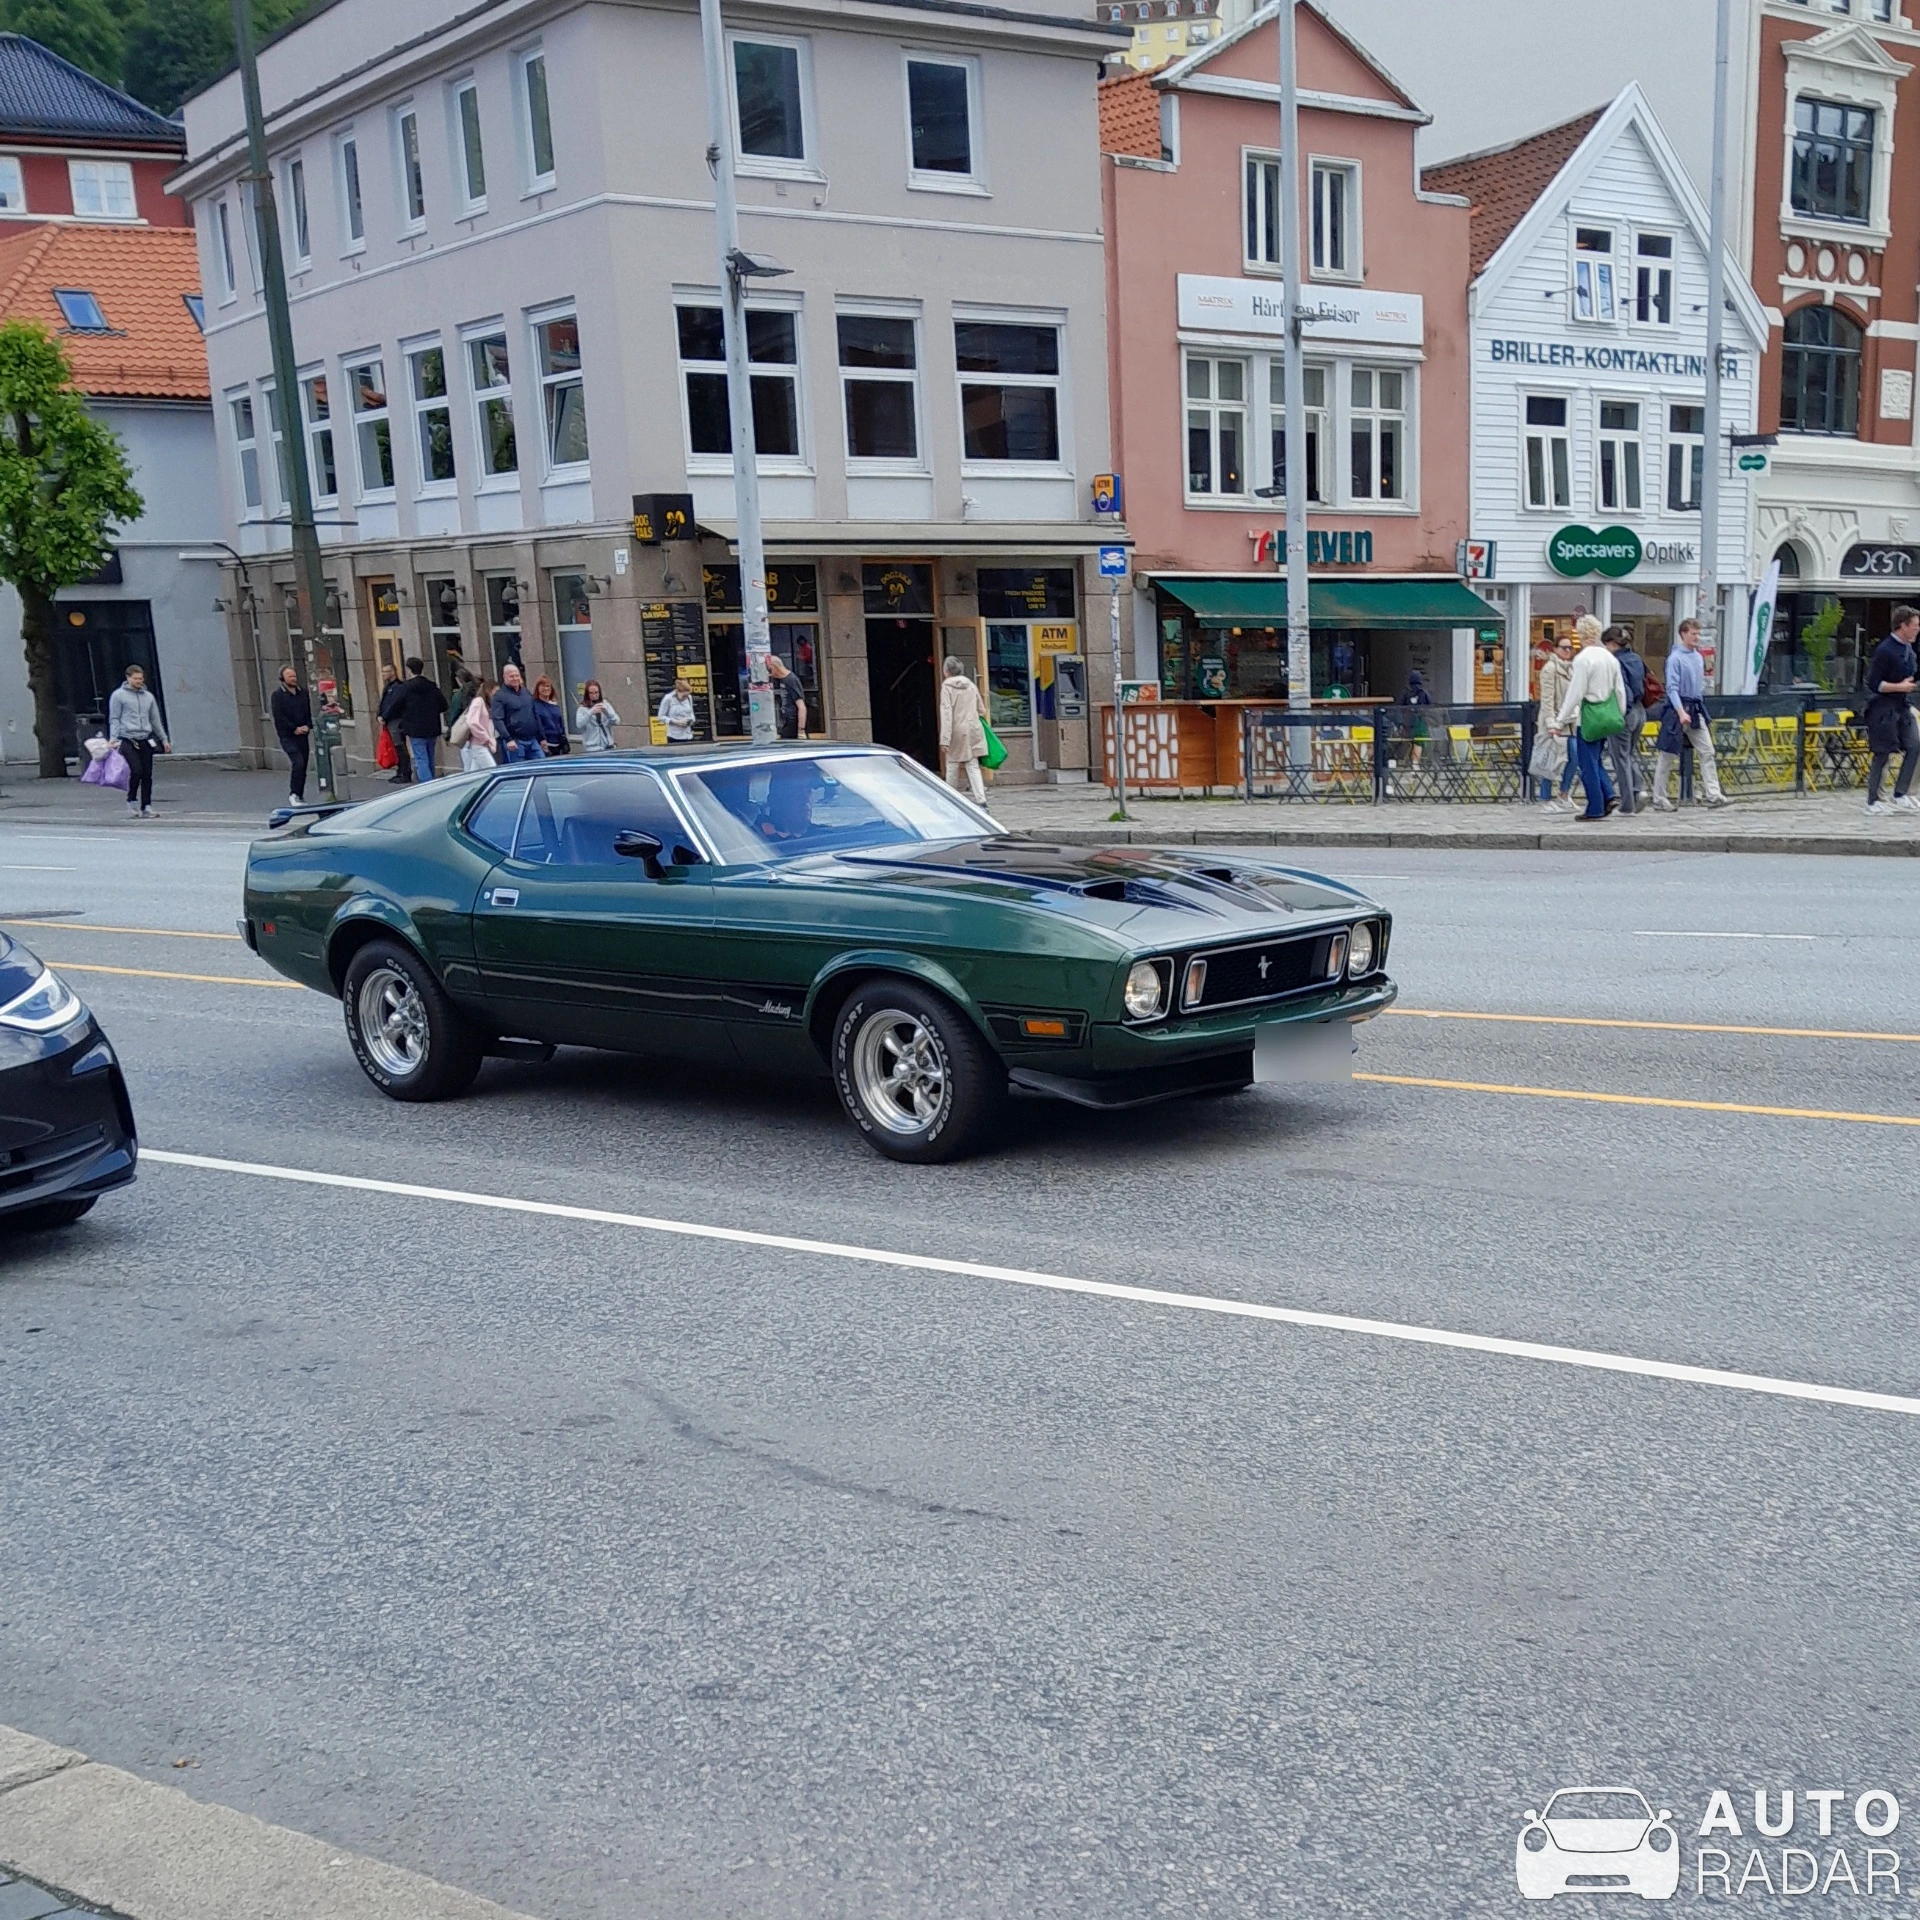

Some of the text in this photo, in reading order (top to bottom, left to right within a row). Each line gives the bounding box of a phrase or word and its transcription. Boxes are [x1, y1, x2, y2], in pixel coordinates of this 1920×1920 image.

[634, 513, 649, 527] DOG
[635, 526, 654, 539] TAILS
[1556, 540, 1636, 561] Specsavers
[1645, 541, 1696, 565] Optikk
[1854, 549, 1912, 574] JEST
[642, 611, 670, 619] DAWGS
[650, 603, 665, 611] HOT
[1041, 627, 1068, 640] ATM
[758, 999, 792, 1019] Mustang
[838, 1001, 864, 1062] SPORT
